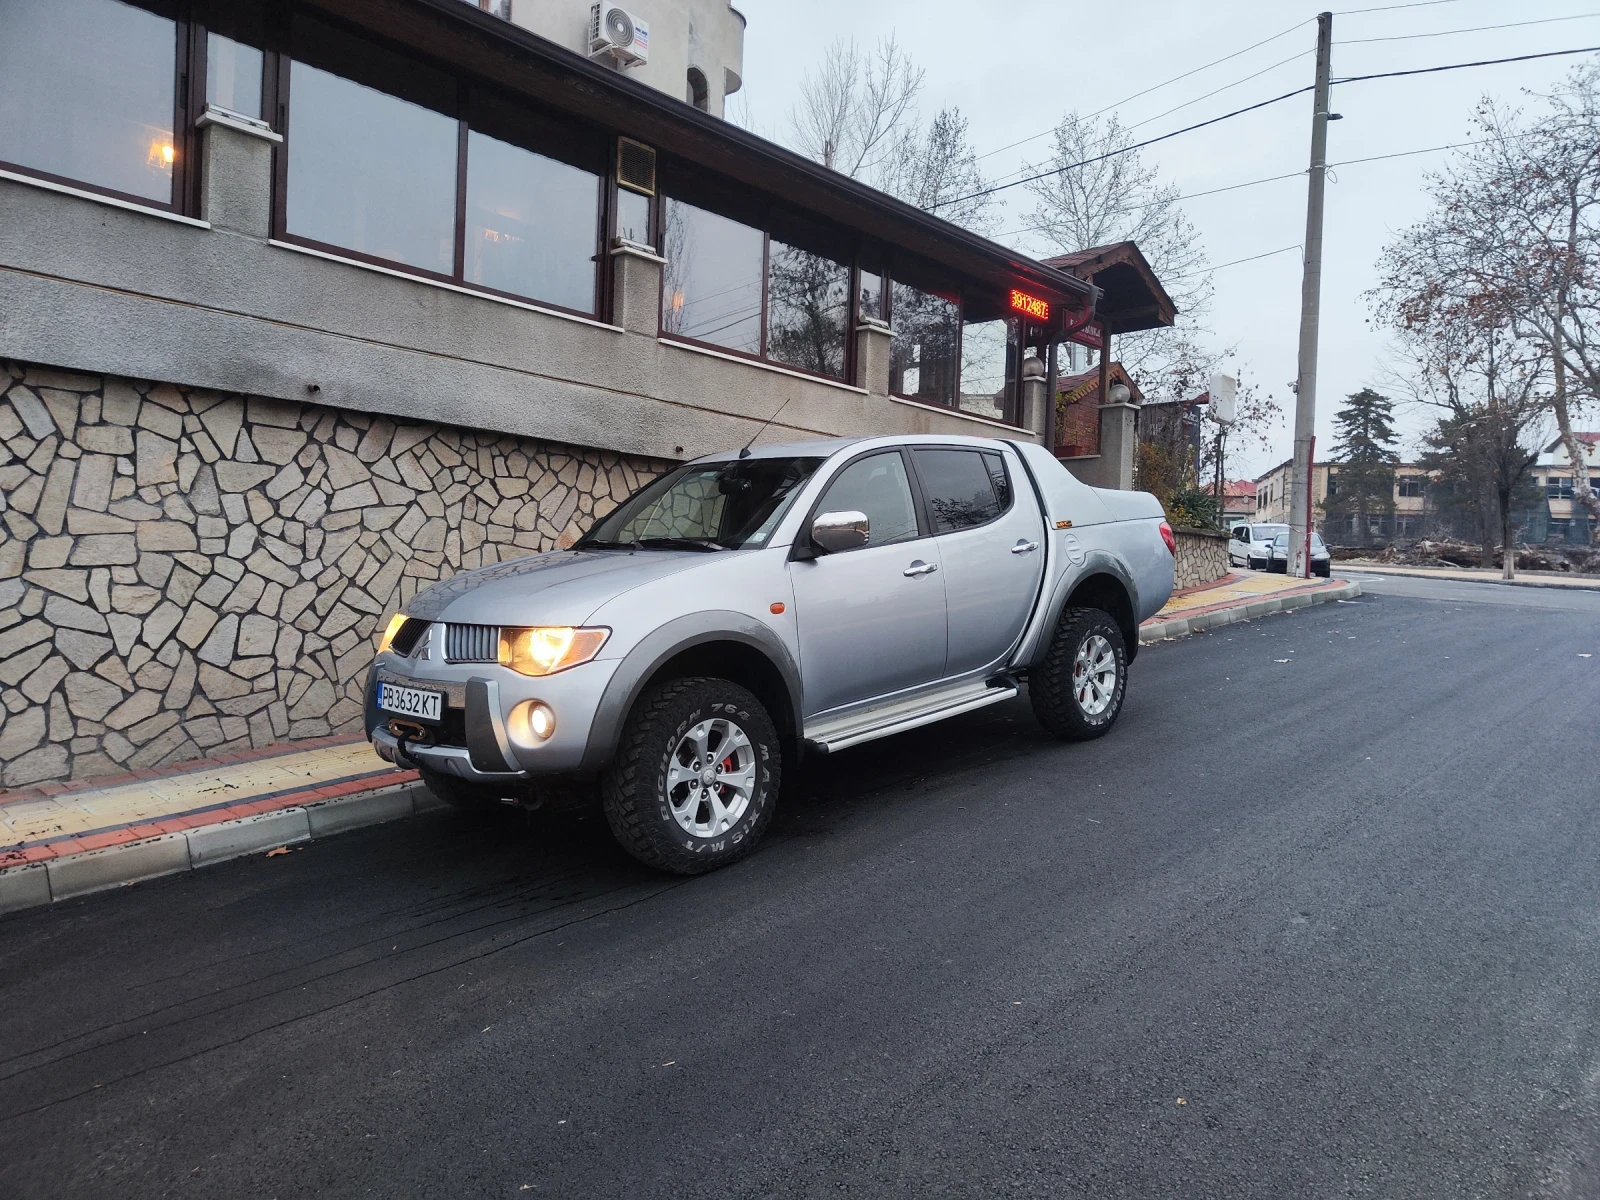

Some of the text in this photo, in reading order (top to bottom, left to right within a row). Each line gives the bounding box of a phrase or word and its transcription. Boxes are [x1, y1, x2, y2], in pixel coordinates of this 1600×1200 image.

[657, 703, 751, 822] BIGHORN 764
[682, 742, 771, 853] MAXXIS M/T
